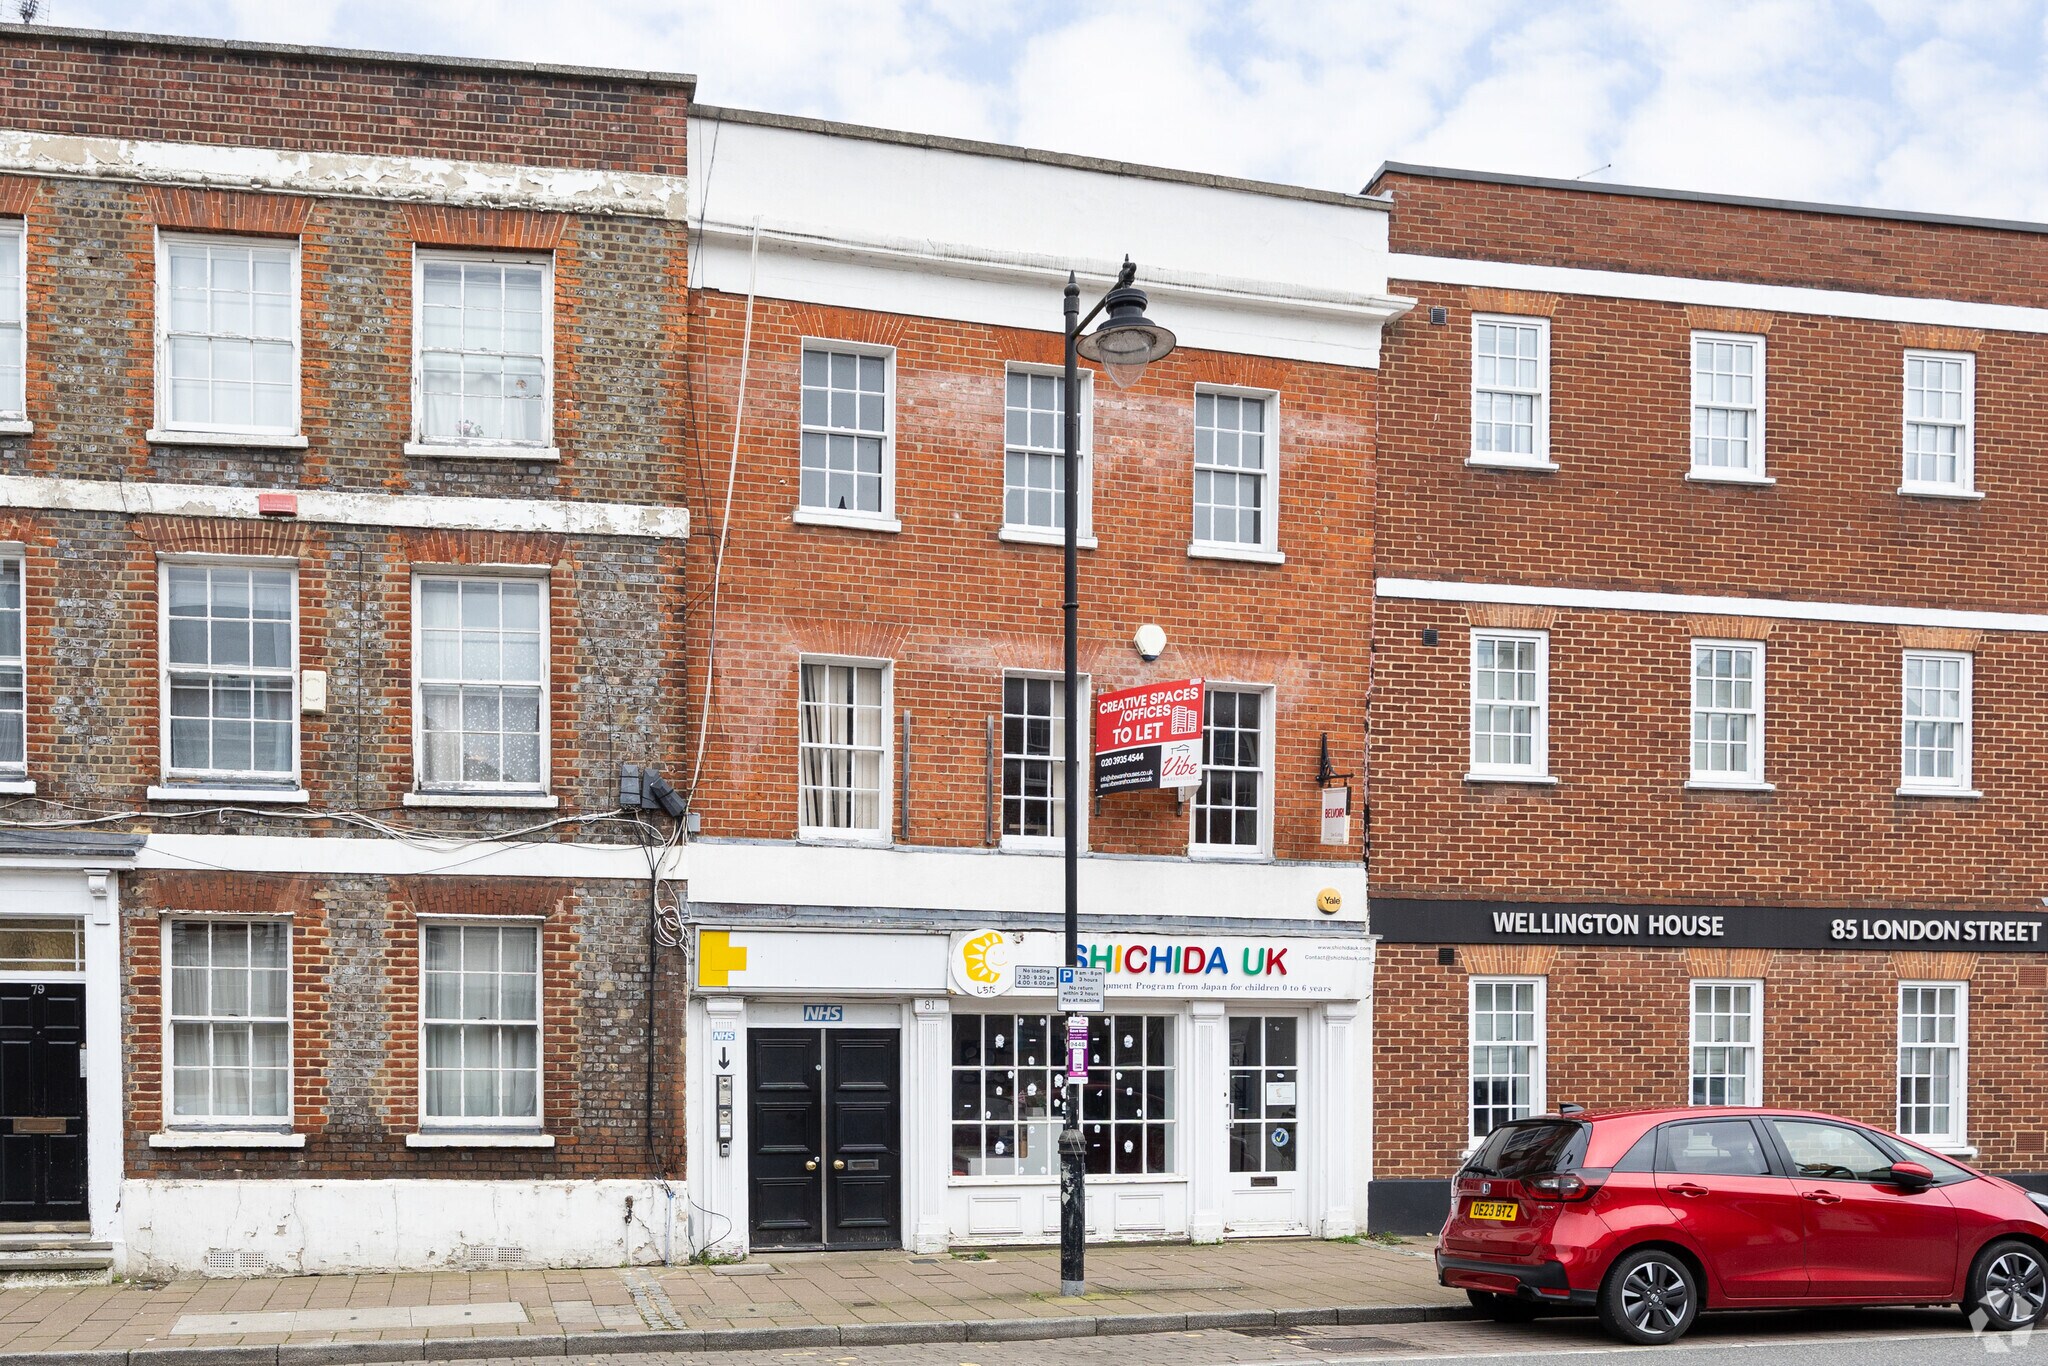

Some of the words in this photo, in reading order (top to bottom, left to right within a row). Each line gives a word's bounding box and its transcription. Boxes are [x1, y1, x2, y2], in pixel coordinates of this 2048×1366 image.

[1100, 694, 1147, 714] CREATIVE
[1150, 687, 1198, 705] SPACES
[1118, 704, 1171, 726] /OFFICES
[1112, 727, 1132, 744] TO
[1136, 722, 1164, 741] LET
[1101, 758, 1112, 767] 020
[1113, 754, 1127, 765] 3935
[1128, 753, 1144, 762] 4544
[1162, 755, 1197, 776] Vibe
[1324, 896, 1340, 904] Yale
[1492, 912, 1638, 934] WELLINGTON
[1648, 915, 1724, 936] HOUSE
[1830, 918, 1857, 940] 85
[1862, 919, 1960, 940] LONDON
[1962, 921, 2042, 942] STREET
[1242, 947, 1288, 976] UK
[1063, 971, 1072, 982] P
[31, 984, 45, 995] 79
[976, 986, 996, 994] しちだ
[1136, 982, 1174, 991] Program
[1178, 982, 1198, 990] from
[1201, 982, 1227, 992] Japan
[1245, 983, 1280, 991] children
[925, 1000, 935, 1010] 81
[805, 1006, 841, 1020] NHS
[714, 1032, 735, 1040] NHS
[1474, 1203, 1494, 1217] OE23
[1495, 1205, 1514, 1218] BTZ
